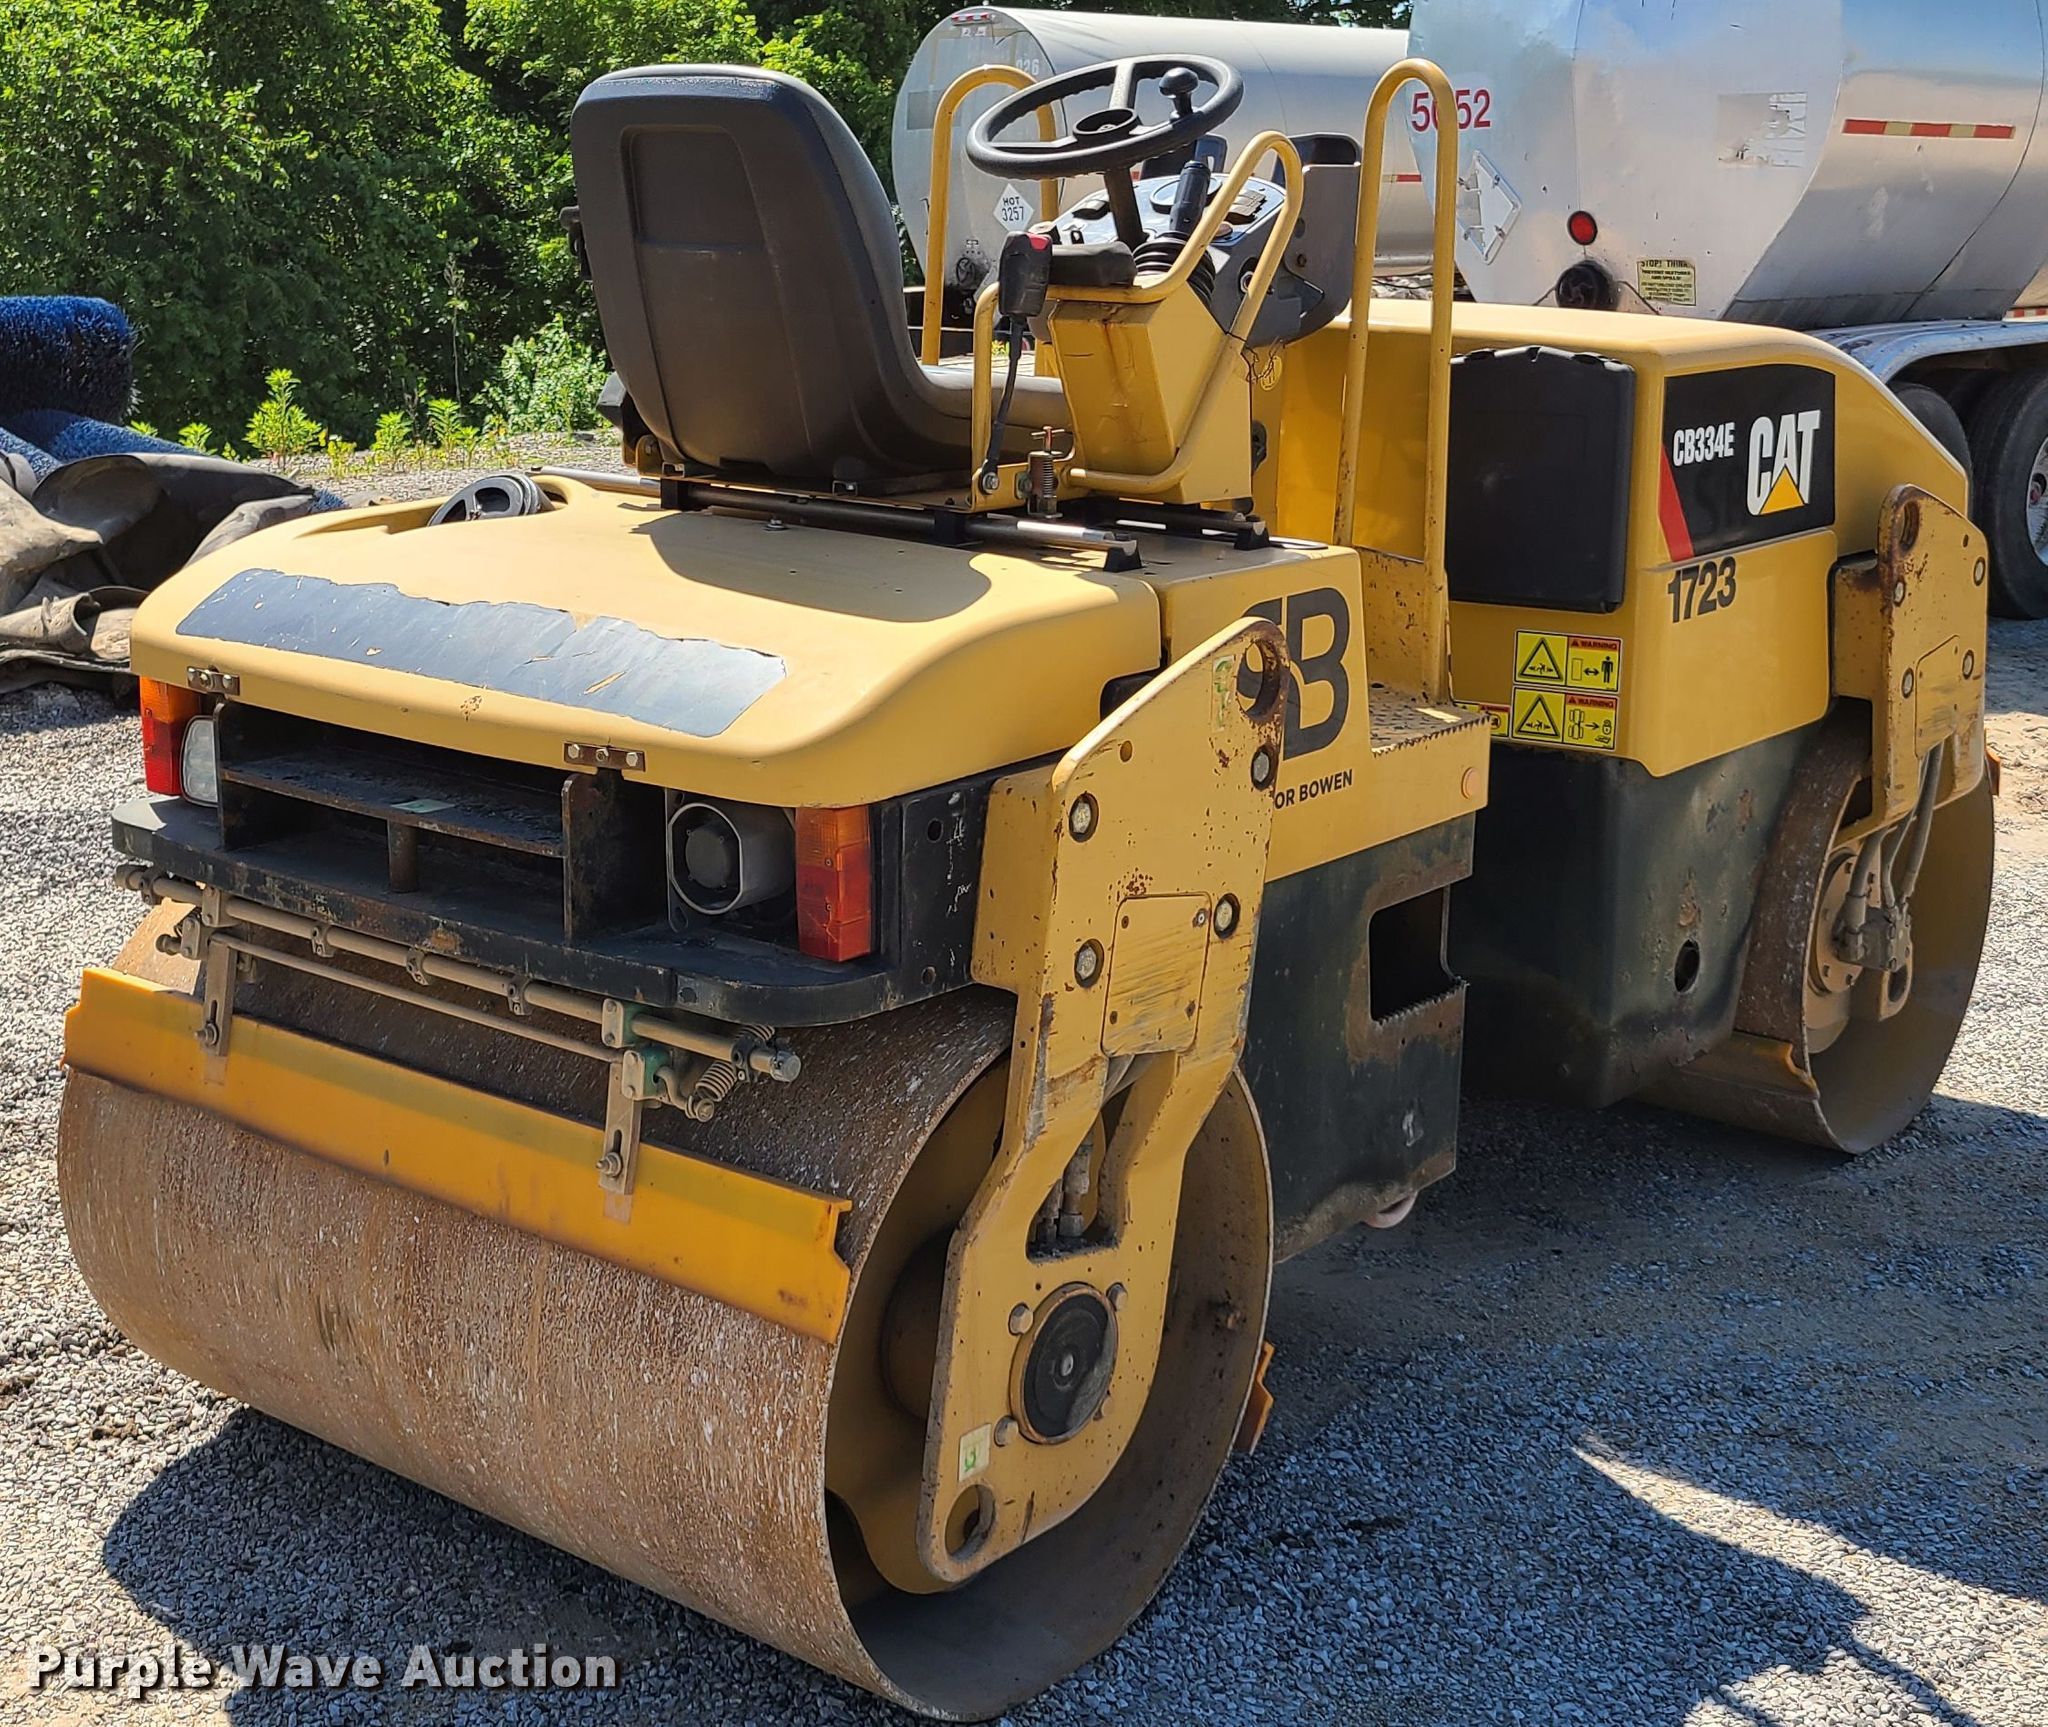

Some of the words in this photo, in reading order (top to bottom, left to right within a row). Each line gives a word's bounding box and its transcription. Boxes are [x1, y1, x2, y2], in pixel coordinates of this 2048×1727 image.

[1003, 196, 1019, 206] HOT
[1002, 206, 1024, 222] 3257
[1673, 422, 1735, 466] CB334E
[1747, 410, 1821, 516] CAT
[1667, 556, 1736, 623] 1723
[1581, 640, 1617, 650] WARNING
[1299, 769, 1353, 802] BOWEN
